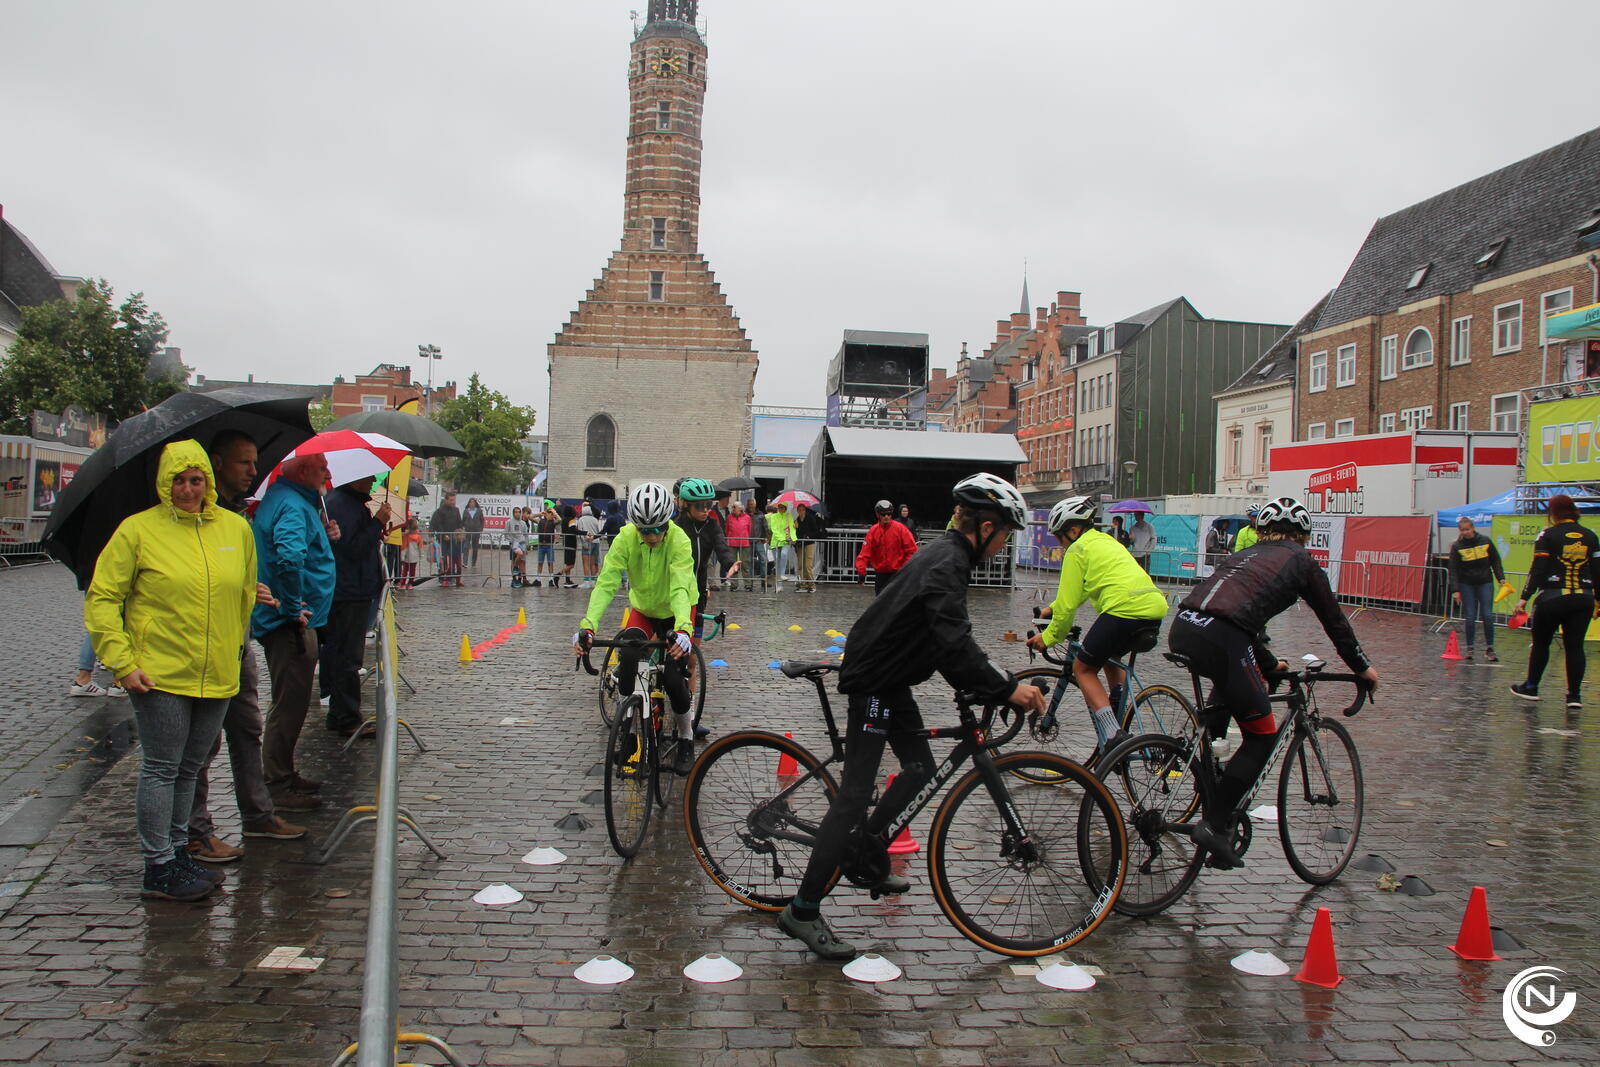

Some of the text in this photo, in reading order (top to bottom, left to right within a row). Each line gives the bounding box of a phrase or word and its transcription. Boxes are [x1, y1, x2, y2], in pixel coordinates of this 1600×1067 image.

[1310, 472, 1332, 488] DRANKEN
[1336, 466, 1355, 481] EVENTS
[480, 506, 510, 516] EYLEN
[1303, 486, 1364, 515] Tom Cambré
[1312, 521, 1332, 529] ERKOOP
[1156, 536, 1167, 544] ets
[888, 759, 954, 838] ARGON 18
[1004, 801, 1023, 830] ARGON
[1054, 936, 1065, 947] DT
[1065, 926, 1083, 941] SWISS
